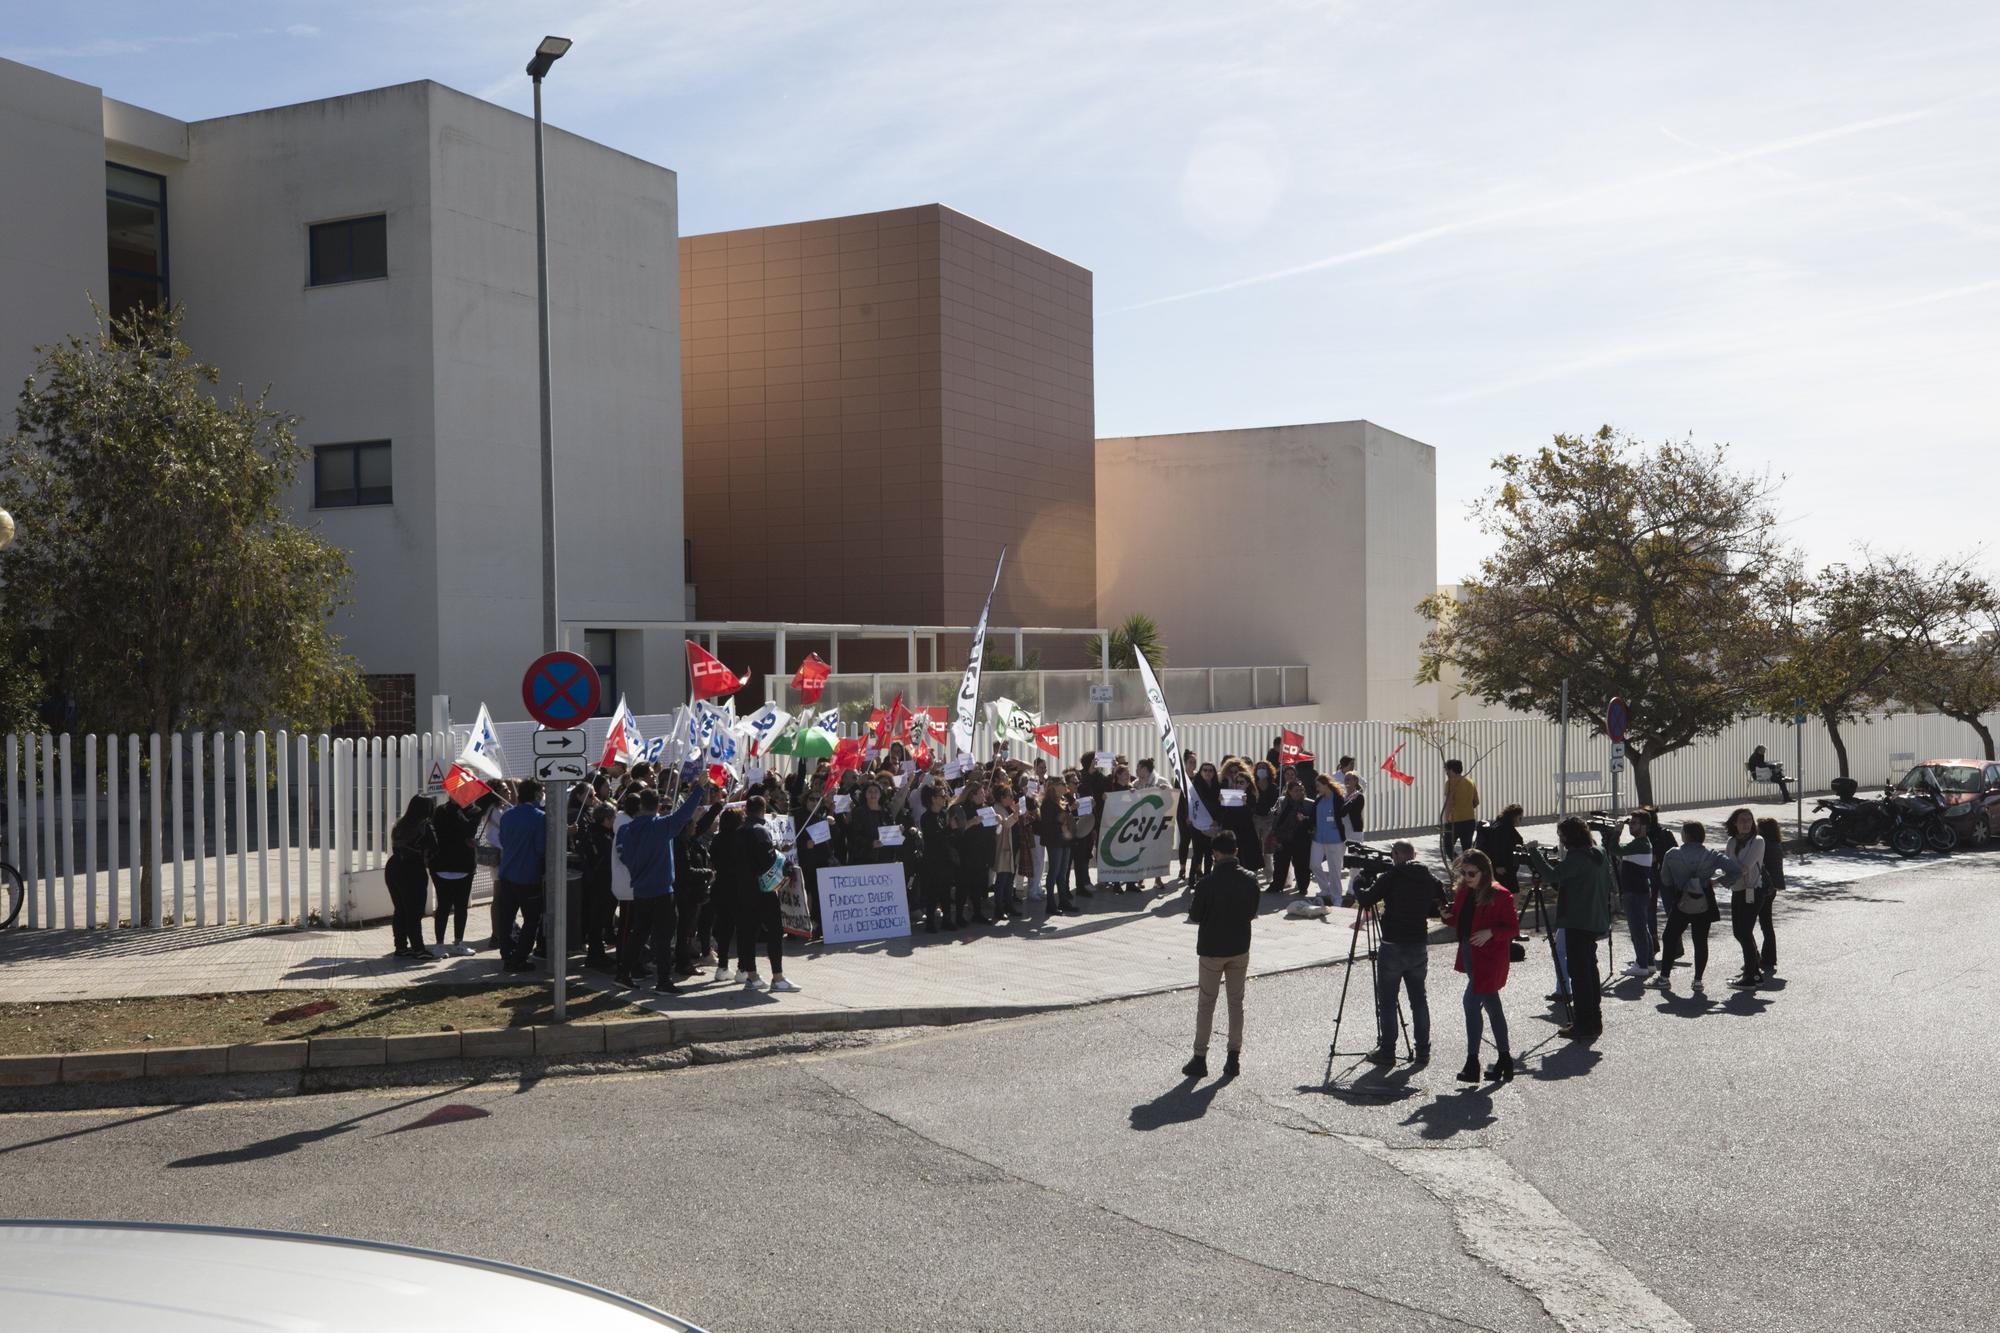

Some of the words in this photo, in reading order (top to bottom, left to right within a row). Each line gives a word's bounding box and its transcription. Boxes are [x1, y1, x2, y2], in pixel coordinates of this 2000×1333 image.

[868, 891, 894, 903] BALEAR
[870, 905, 898, 917] SUPORT
[844, 923, 853, 934] LA
